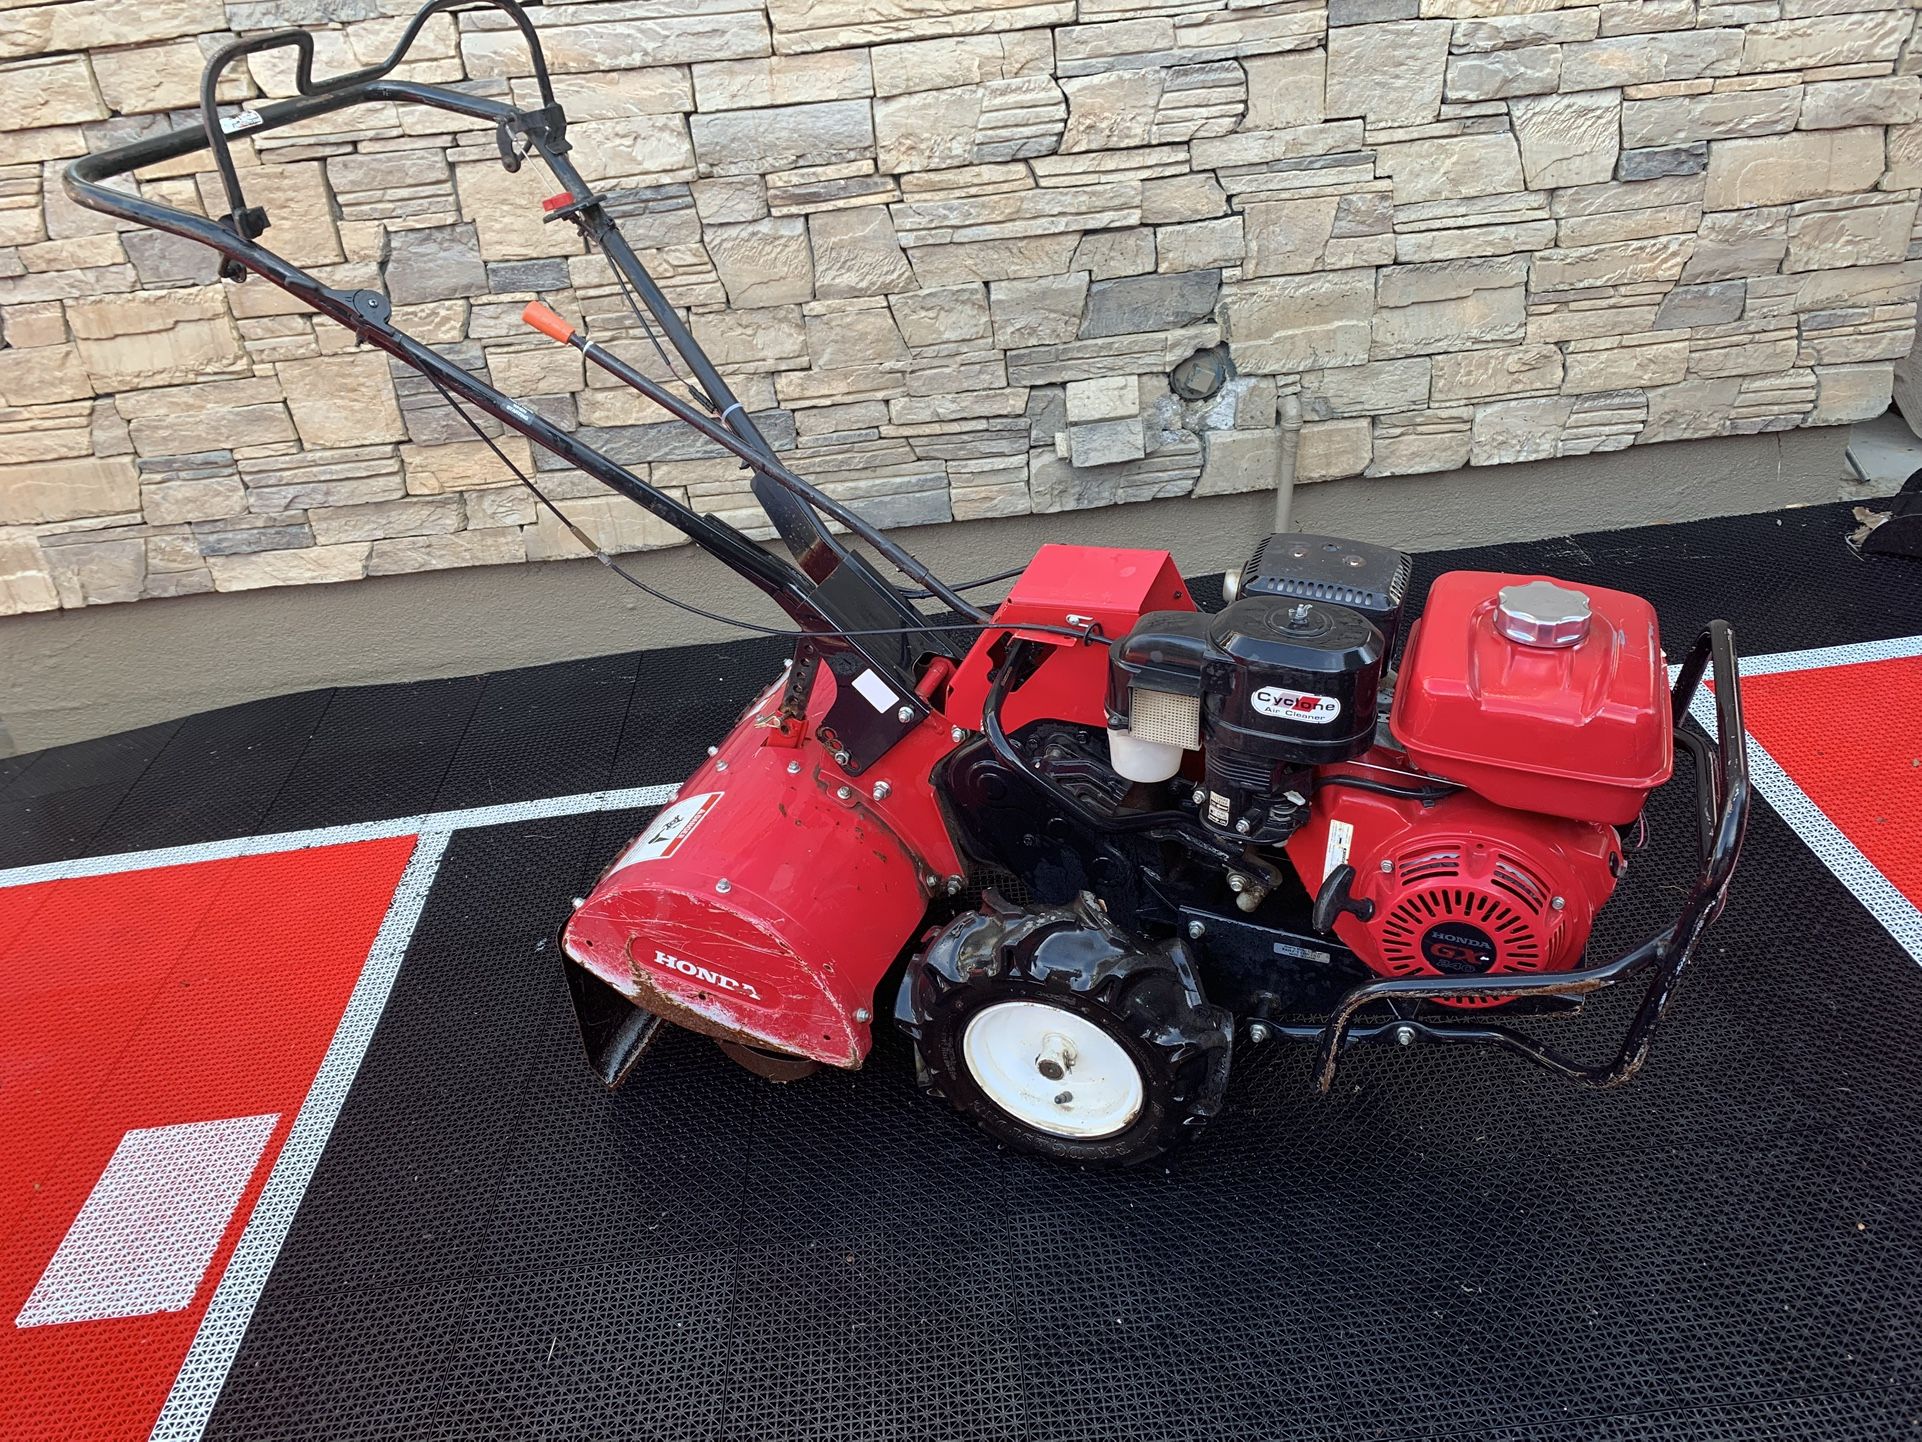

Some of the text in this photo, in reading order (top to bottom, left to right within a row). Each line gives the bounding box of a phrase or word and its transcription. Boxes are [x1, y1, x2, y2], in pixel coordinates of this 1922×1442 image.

[1257, 692, 1335, 711] Cyclone
[1285, 711, 1325, 720] Cleaner
[1431, 931, 1491, 949] HONDA
[1431, 943, 1487, 964] GX
[654, 950, 761, 1000] HONDA
